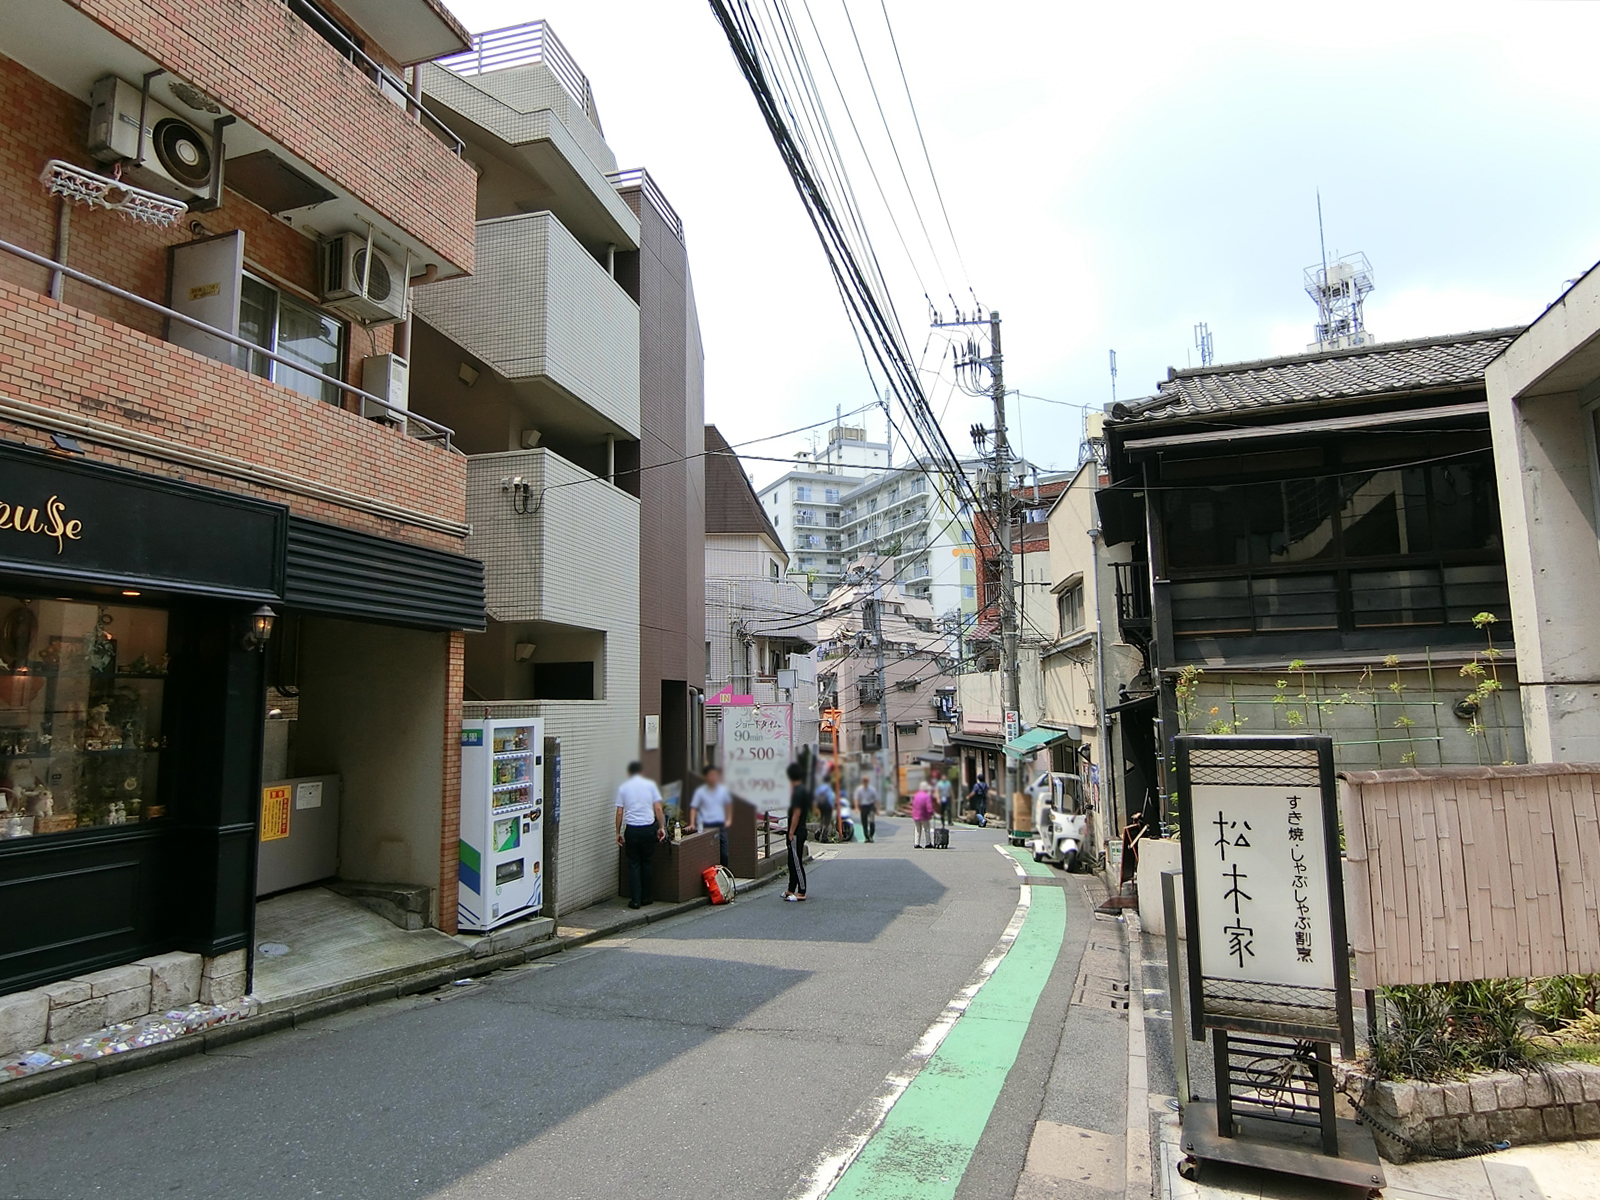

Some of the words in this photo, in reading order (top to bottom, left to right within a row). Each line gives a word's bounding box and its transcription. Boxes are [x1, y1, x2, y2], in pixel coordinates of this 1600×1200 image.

[719, 693, 731, 703] IN
[735, 720, 781, 730] ショートタイム
[1212, 810, 1256, 968] 松木家
